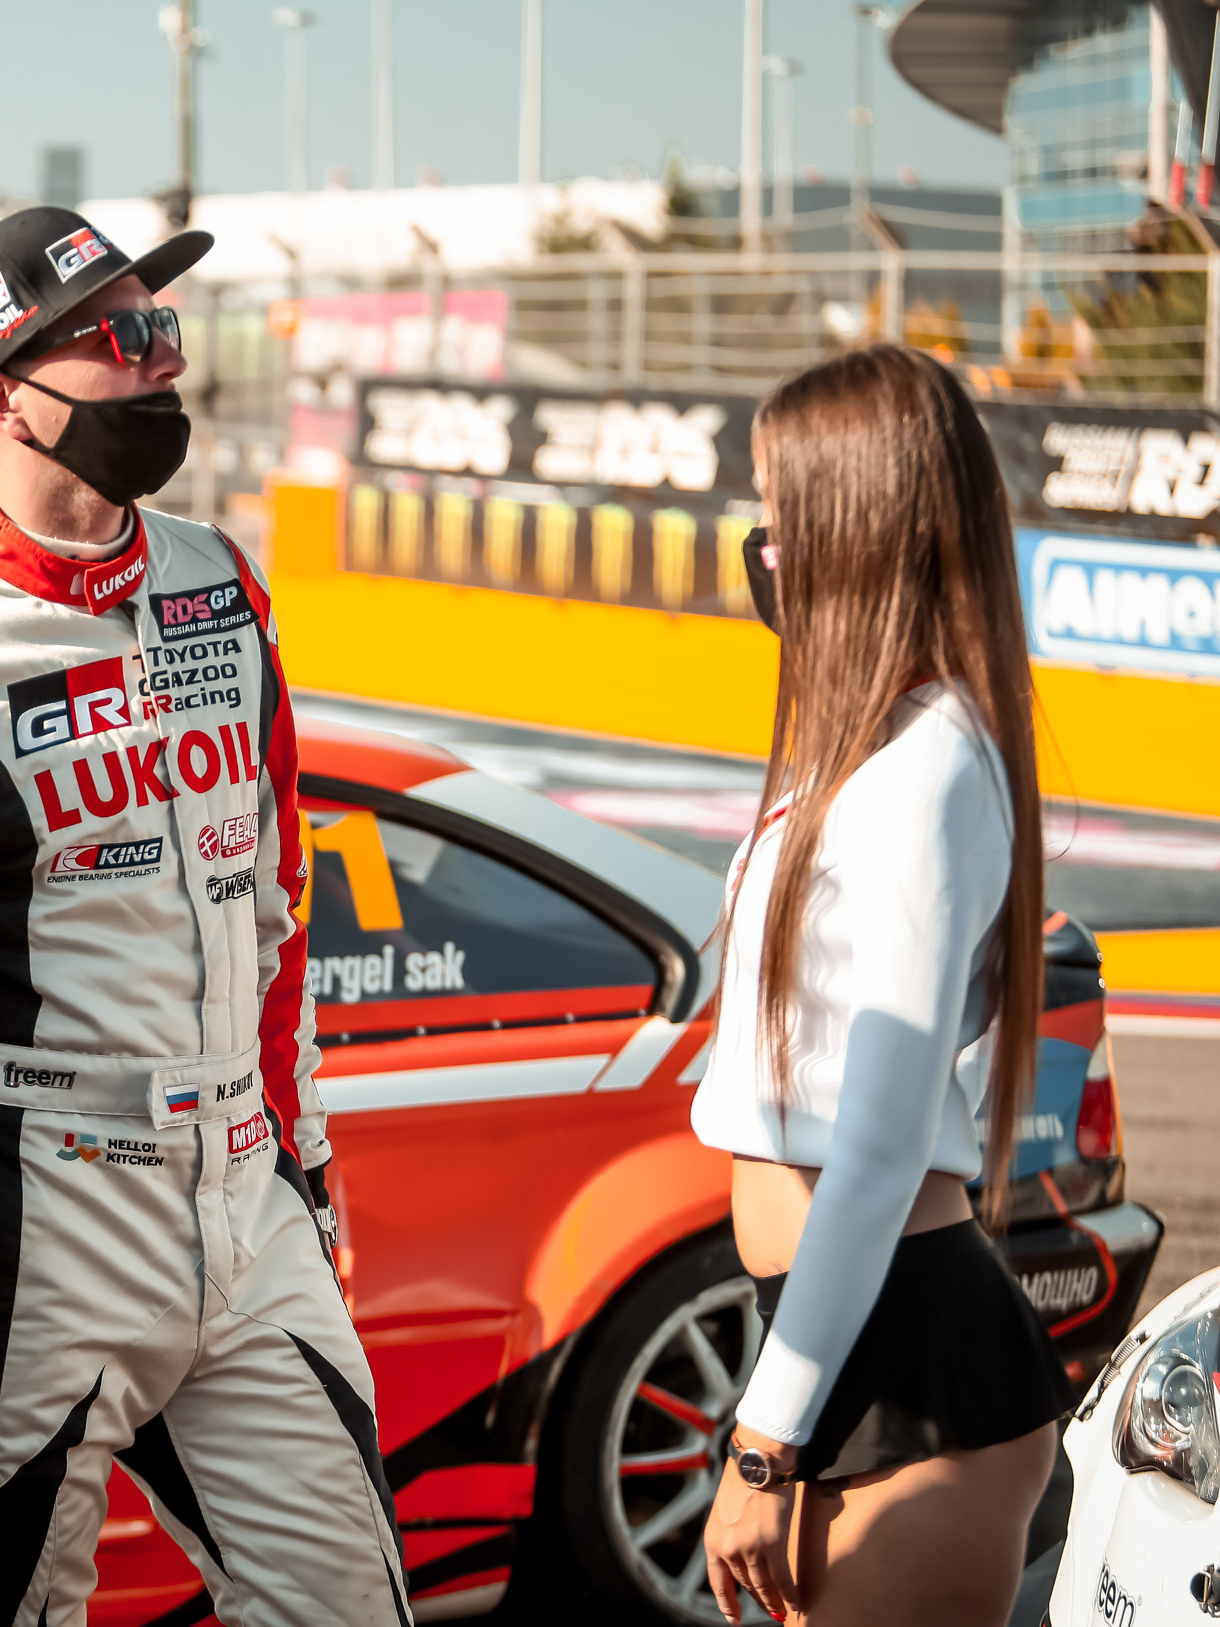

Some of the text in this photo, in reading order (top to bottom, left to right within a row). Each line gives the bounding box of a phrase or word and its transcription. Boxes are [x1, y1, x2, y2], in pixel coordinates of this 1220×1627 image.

[58, 238, 107, 276] GR
[93, 554, 146, 600] LUKOIL
[1045, 564, 1220, 648] AIMO
[163, 611, 251, 637] RUSSIAN DRIFT SERIES
[16, 687, 130, 750] GR
[33, 721, 258, 833] LUKOIL
[98, 842, 160, 866] KING
[78, 872, 112, 882] BEARING
[114, 866, 161, 879] SPECIALISTS
[308, 941, 466, 1003] ergei sak
[4, 1063, 75, 1088] freem
[106, 1153, 164, 1167] KITCHEN
[107, 1138, 157, 1153] HELLO!
